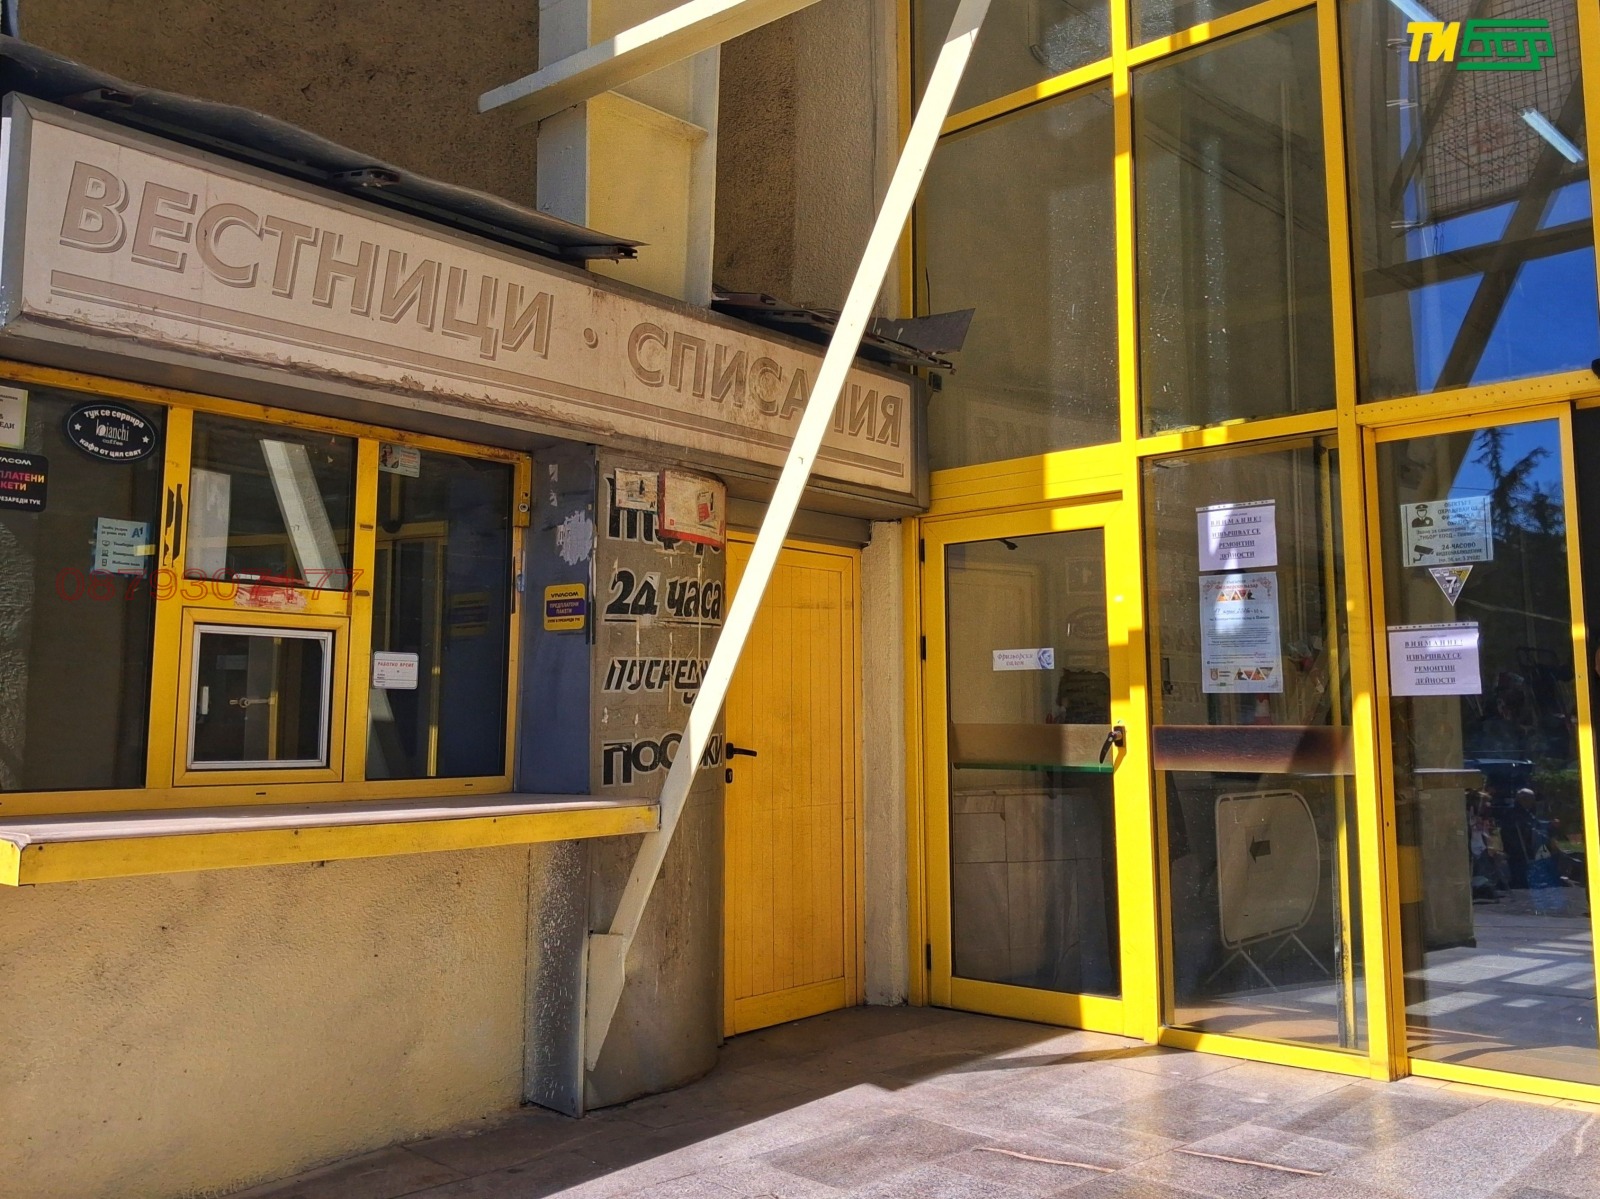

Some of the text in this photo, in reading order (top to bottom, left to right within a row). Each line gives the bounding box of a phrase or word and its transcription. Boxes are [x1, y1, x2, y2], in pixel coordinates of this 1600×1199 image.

[59, 161, 554, 360] ВЕСТНИЦИ
[84, 409, 100, 419] тук
[111, 410, 145, 429] сервира
[95, 419, 130, 442] bianchi
[131, 526, 144, 538] A1
[605, 569, 722, 620] 24 часа
[1452, 652, 1462, 660] СЕ
[1414, 676, 1456, 686] ДЕЙНОСТИ
